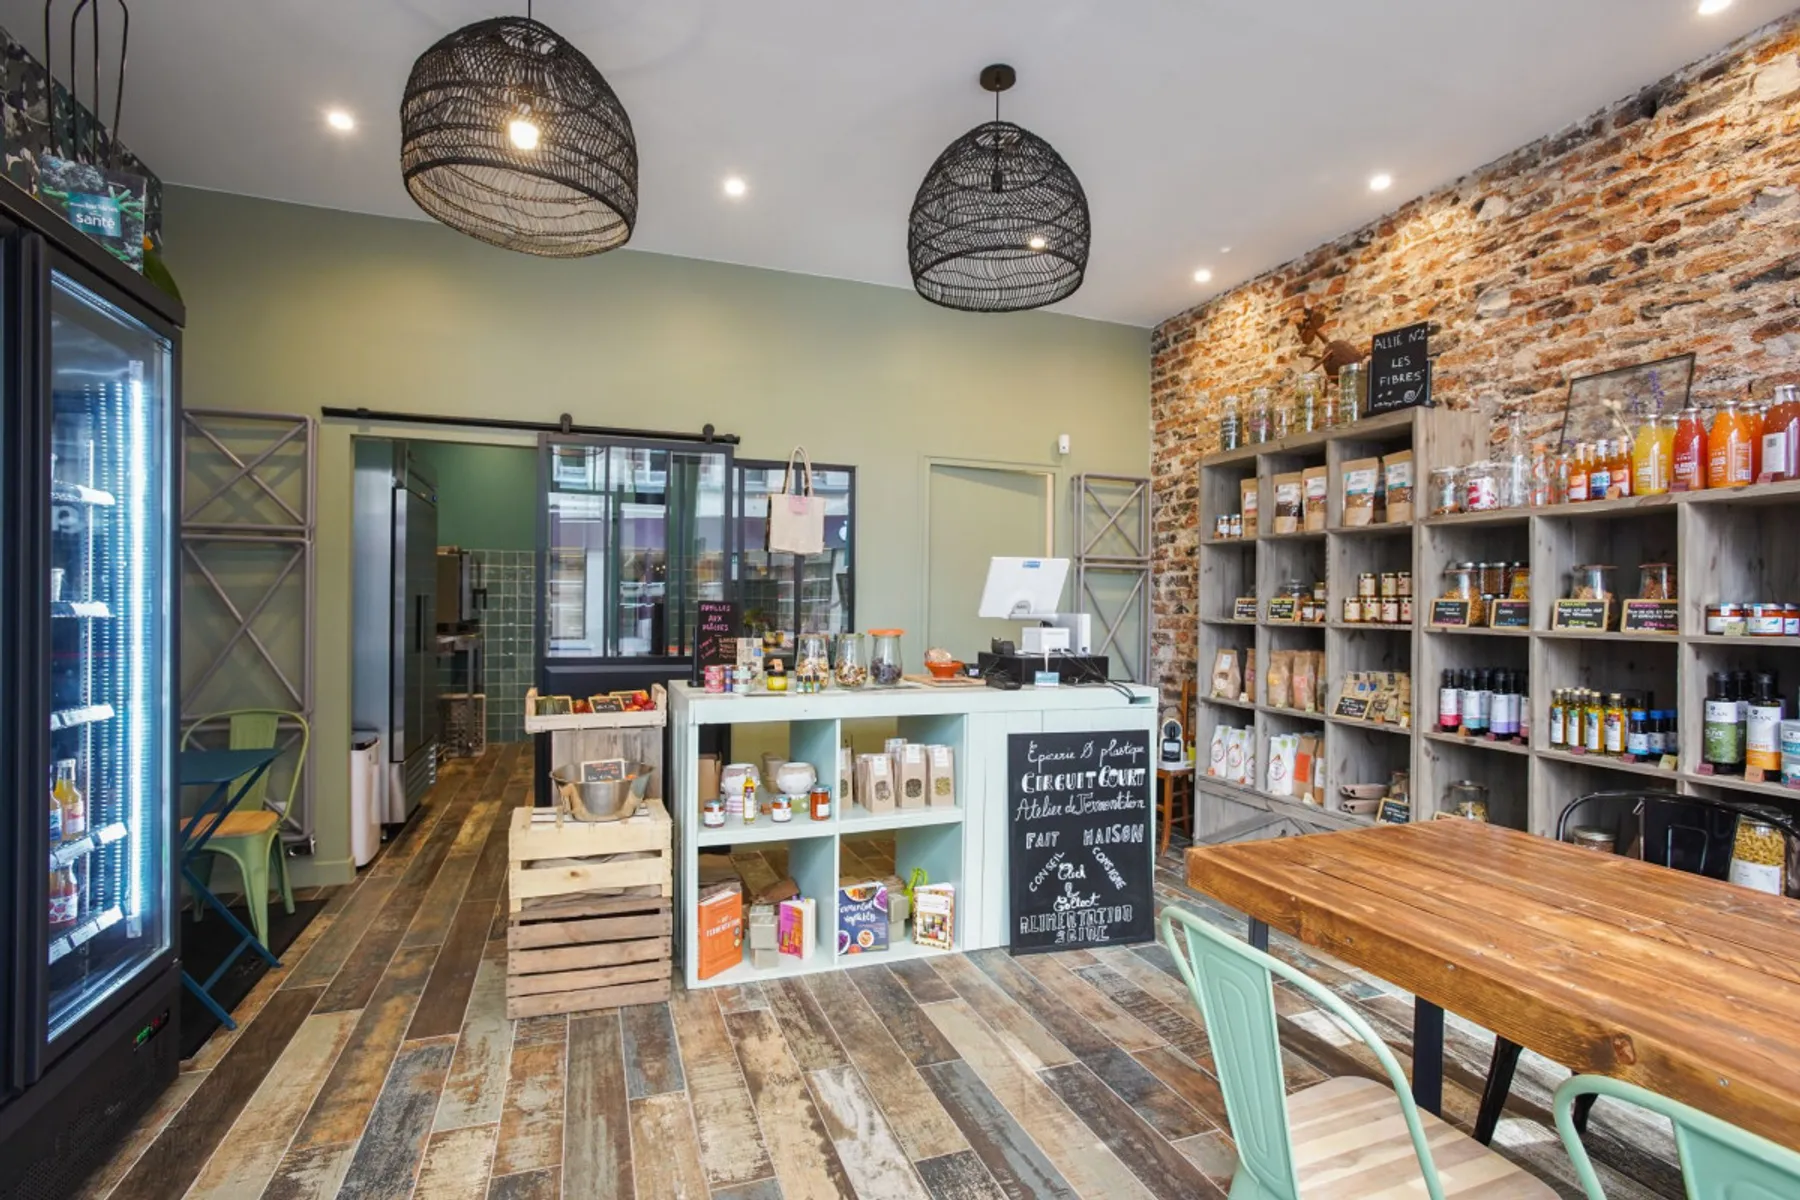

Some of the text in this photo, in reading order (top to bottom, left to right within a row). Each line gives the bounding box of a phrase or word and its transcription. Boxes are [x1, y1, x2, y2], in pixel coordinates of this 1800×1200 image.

[1391, 356, 1412, 369] LES
[1379, 371, 1422, 387] FIBRES
[1099, 738, 1146, 768] plastique
[1021, 771, 1097, 794] CIRCUIT
[1014, 795, 1063, 822] Atelier
[1064, 795, 1081, 816] de
[1025, 823, 1145, 850] FAIT MAISON
[1028, 852, 1066, 893] CONSEIL
